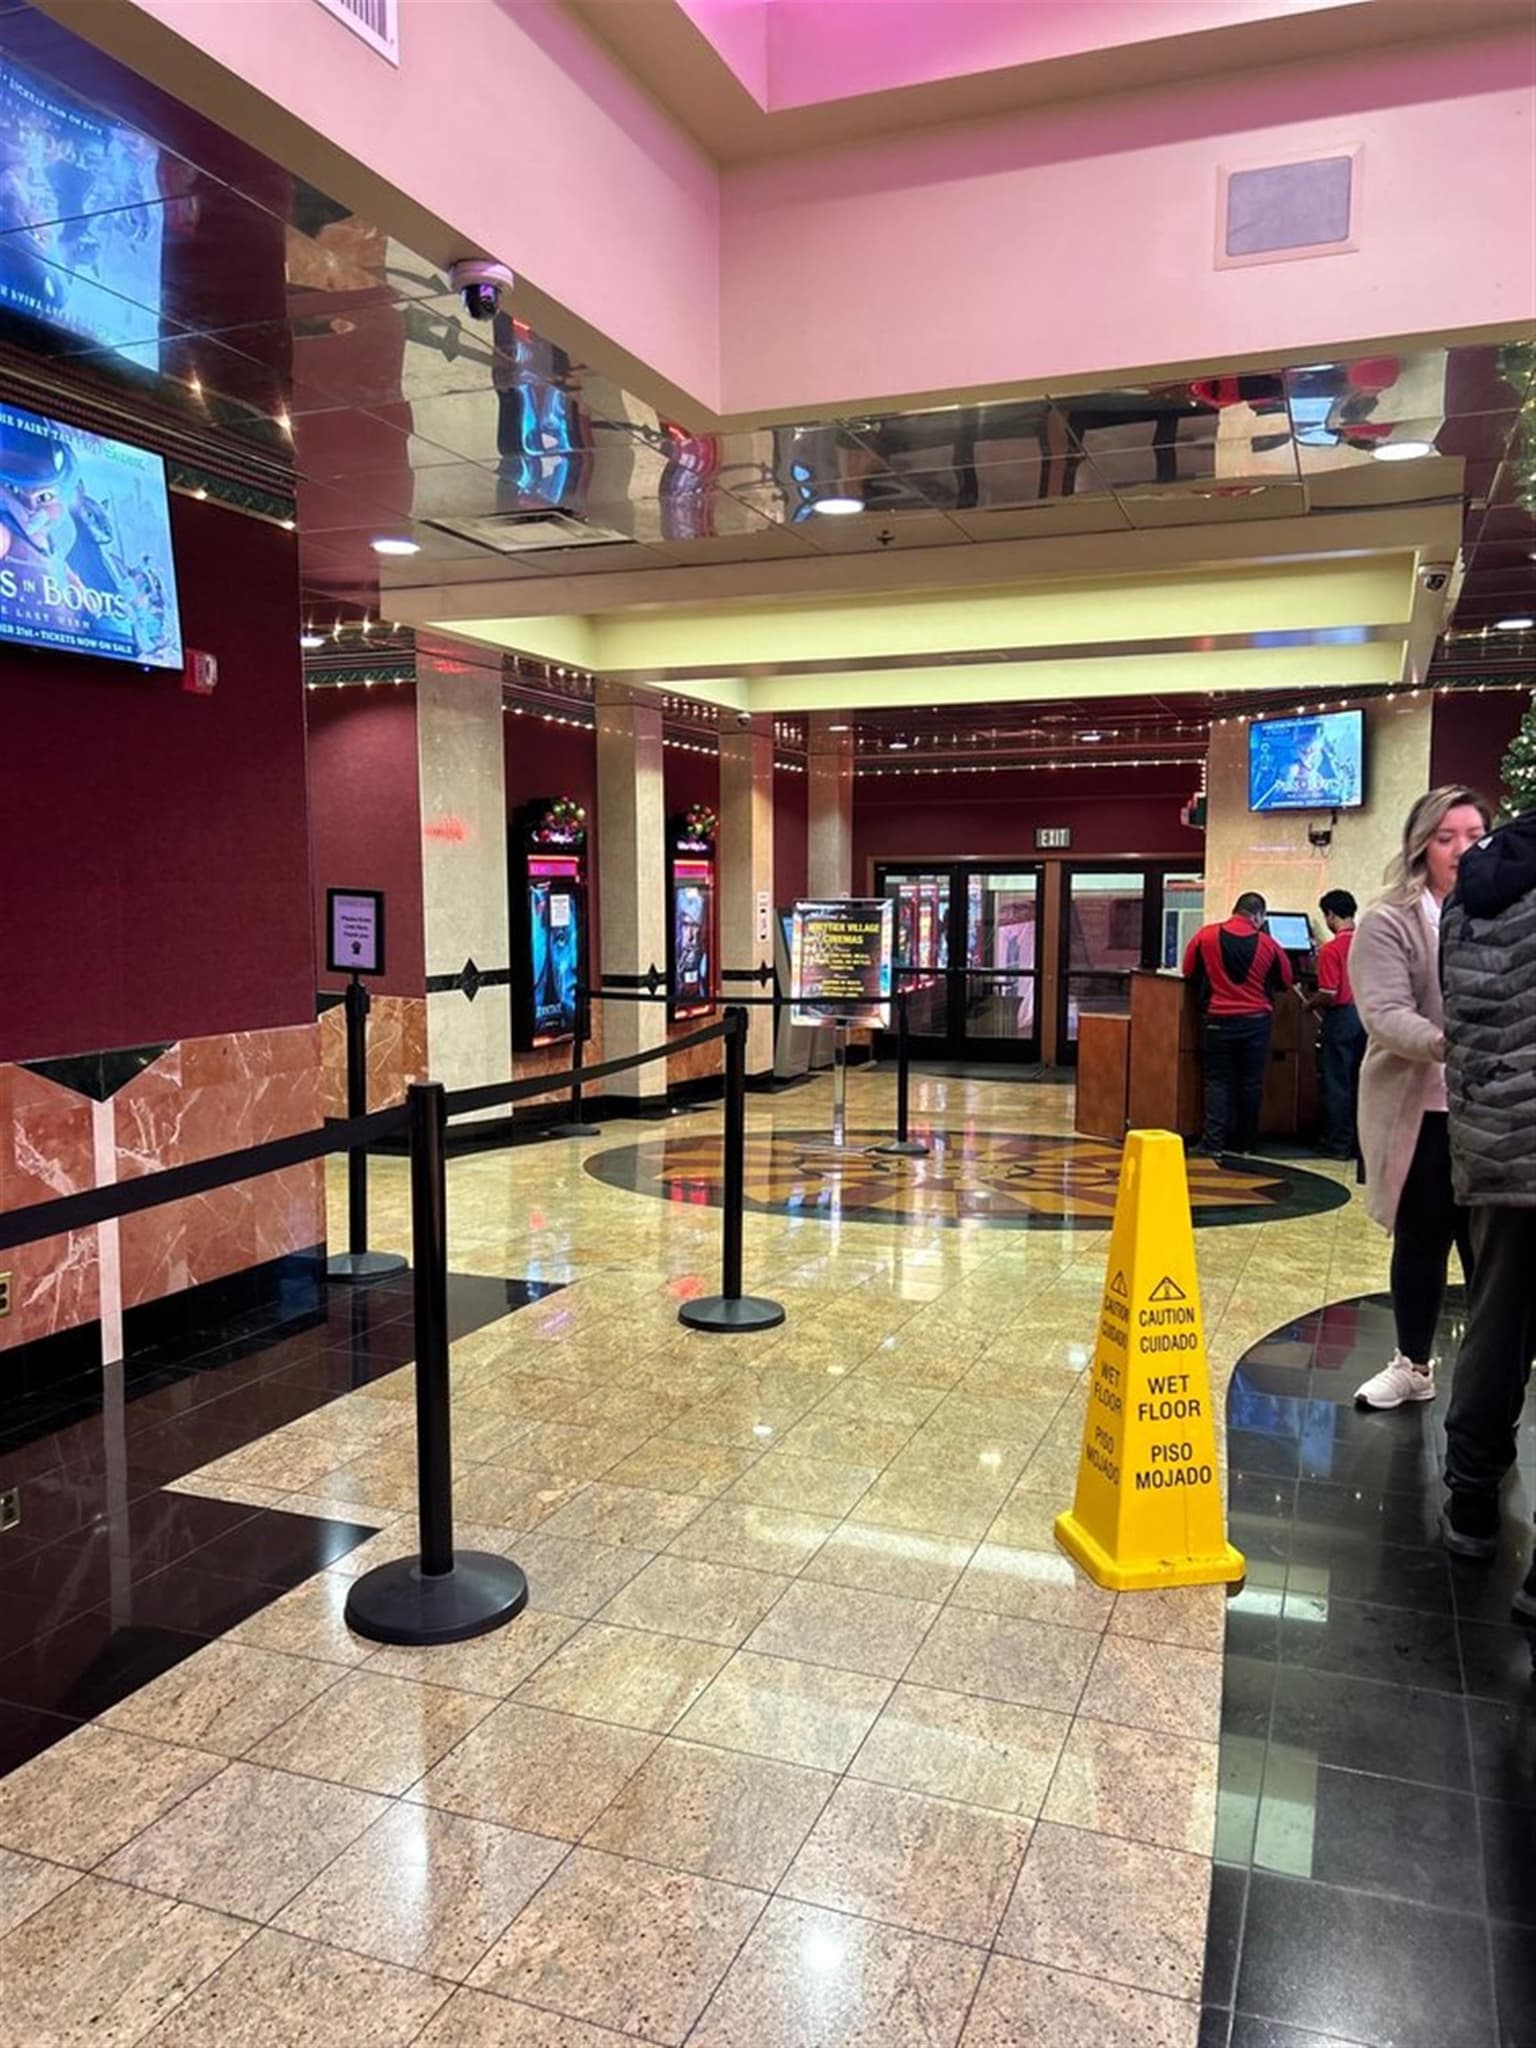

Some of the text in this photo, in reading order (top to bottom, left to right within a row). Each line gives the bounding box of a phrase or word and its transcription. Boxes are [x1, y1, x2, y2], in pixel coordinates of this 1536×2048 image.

[42, 574, 129, 621] BOOTS
[40, 630, 76, 645] TICKETS
[77, 637, 97, 648] NOW
[99, 640, 113, 650] ON
[113, 642, 133, 654] SALE
[1040, 829, 1068, 847] EXIT
[847, 923, 880, 933] VILLAGE
[823, 934, 864, 945] CINEMAS
[1139, 1307, 1195, 1327] CAUTION
[1140, 1333, 1197, 1353] CUIDADO
[1101, 1362, 1121, 1388] WET
[1147, 1375, 1190, 1395] WET
[1095, 1381, 1122, 1416] FLOOR
[1138, 1399, 1201, 1421] FLOOR
[1151, 1442, 1192, 1463] PISO
[1135, 1465, 1212, 1490] MOJADO
